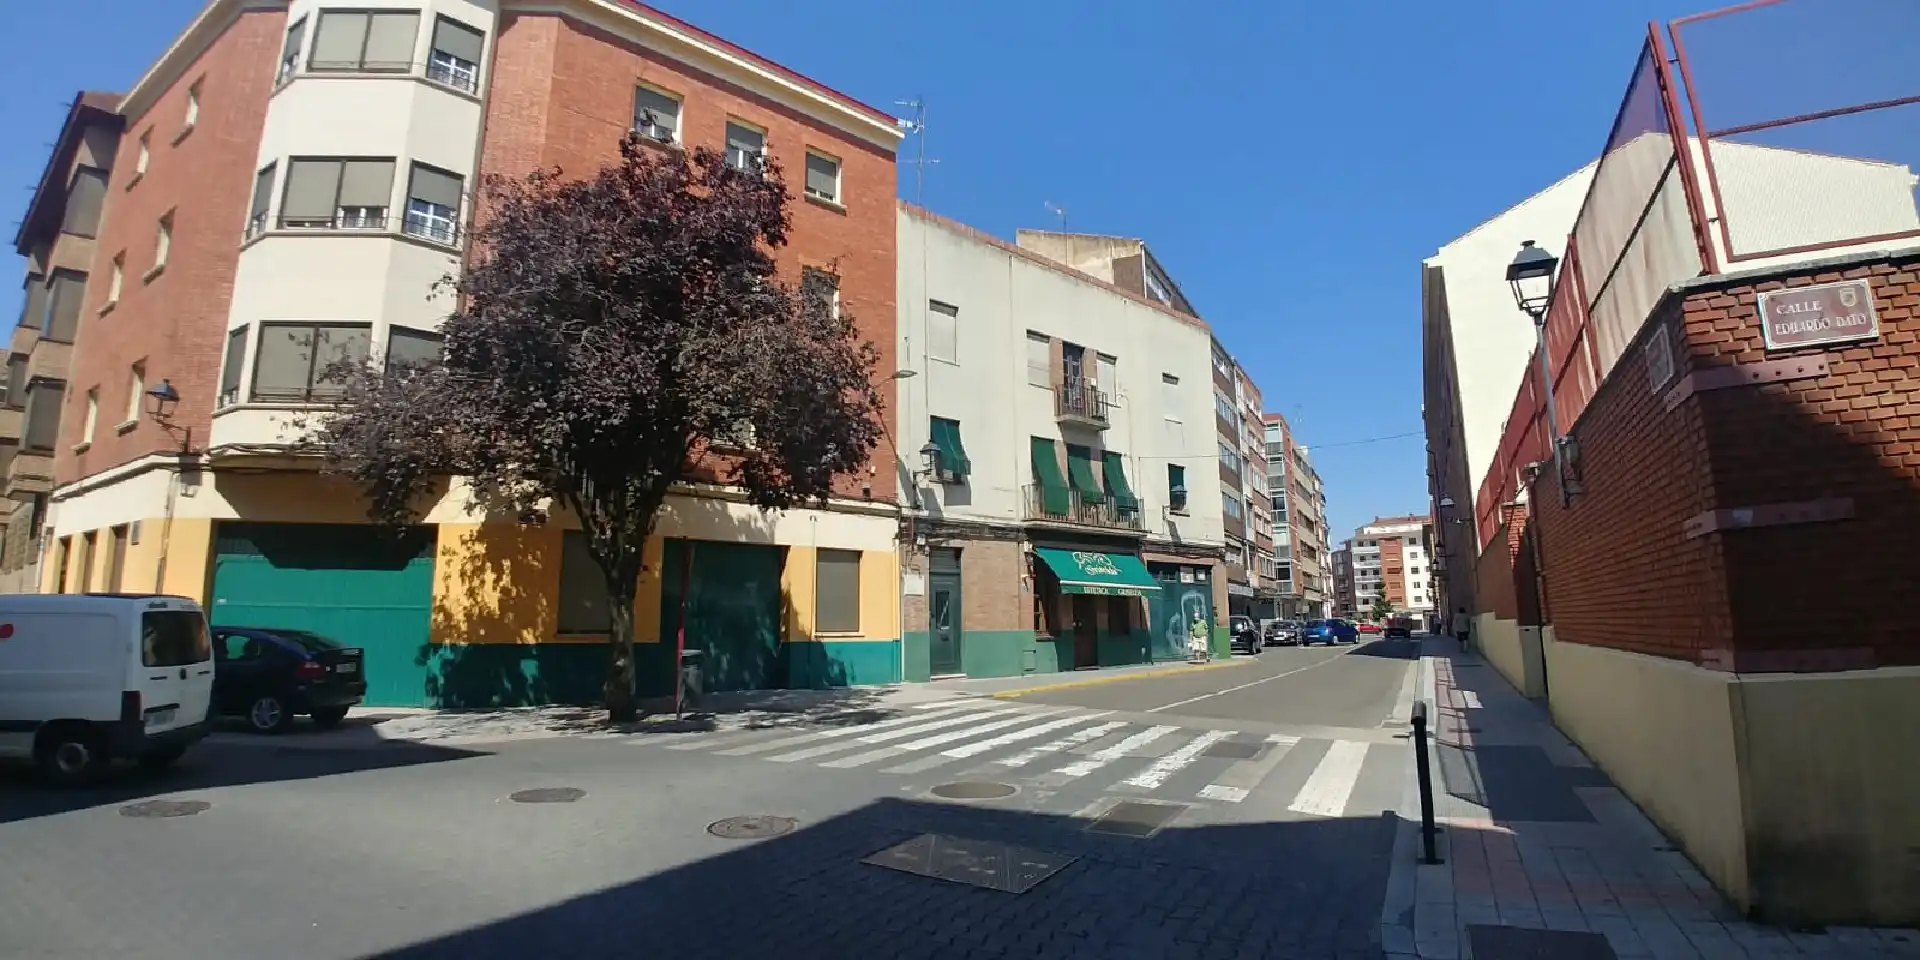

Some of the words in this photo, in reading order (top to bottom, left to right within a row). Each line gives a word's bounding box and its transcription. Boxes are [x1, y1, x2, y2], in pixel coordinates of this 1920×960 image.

[1776, 300, 1823, 315] CALLE
[1775, 317, 1831, 335] EDUARDO
[1836, 312, 1867, 327] DATO
